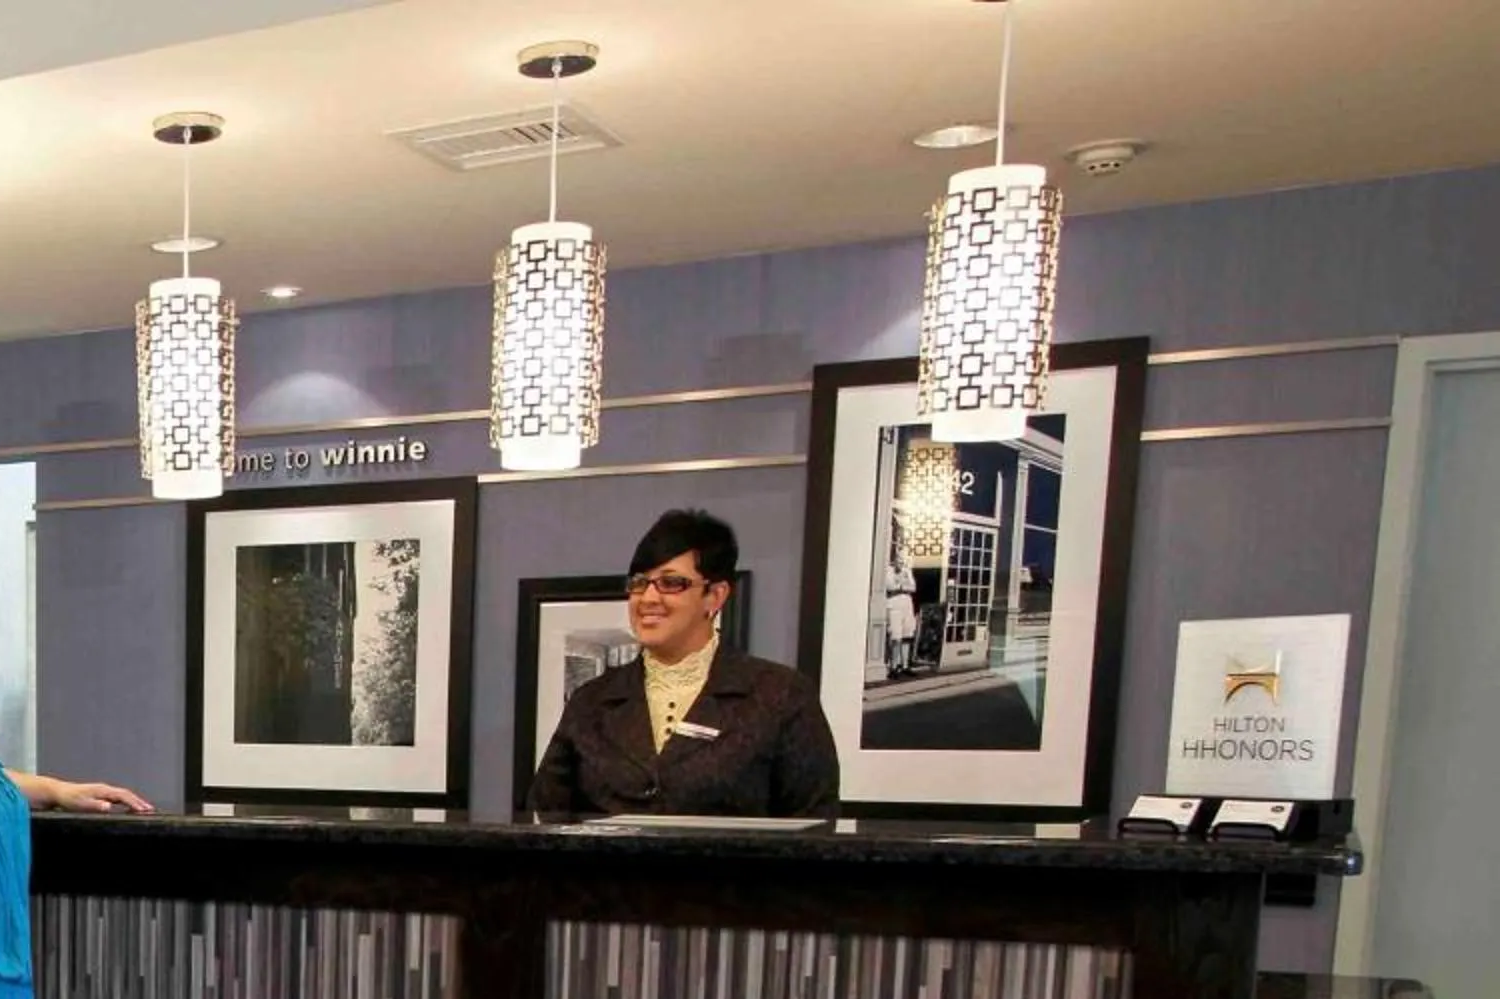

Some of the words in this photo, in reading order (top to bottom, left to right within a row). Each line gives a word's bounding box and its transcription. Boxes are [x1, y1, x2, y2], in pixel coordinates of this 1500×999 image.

[284, 448, 309, 470] to
[320, 436, 426, 466] winnie
[1213, 716, 1286, 733] HILTON
[1182, 739, 1314, 761] HHONORS
